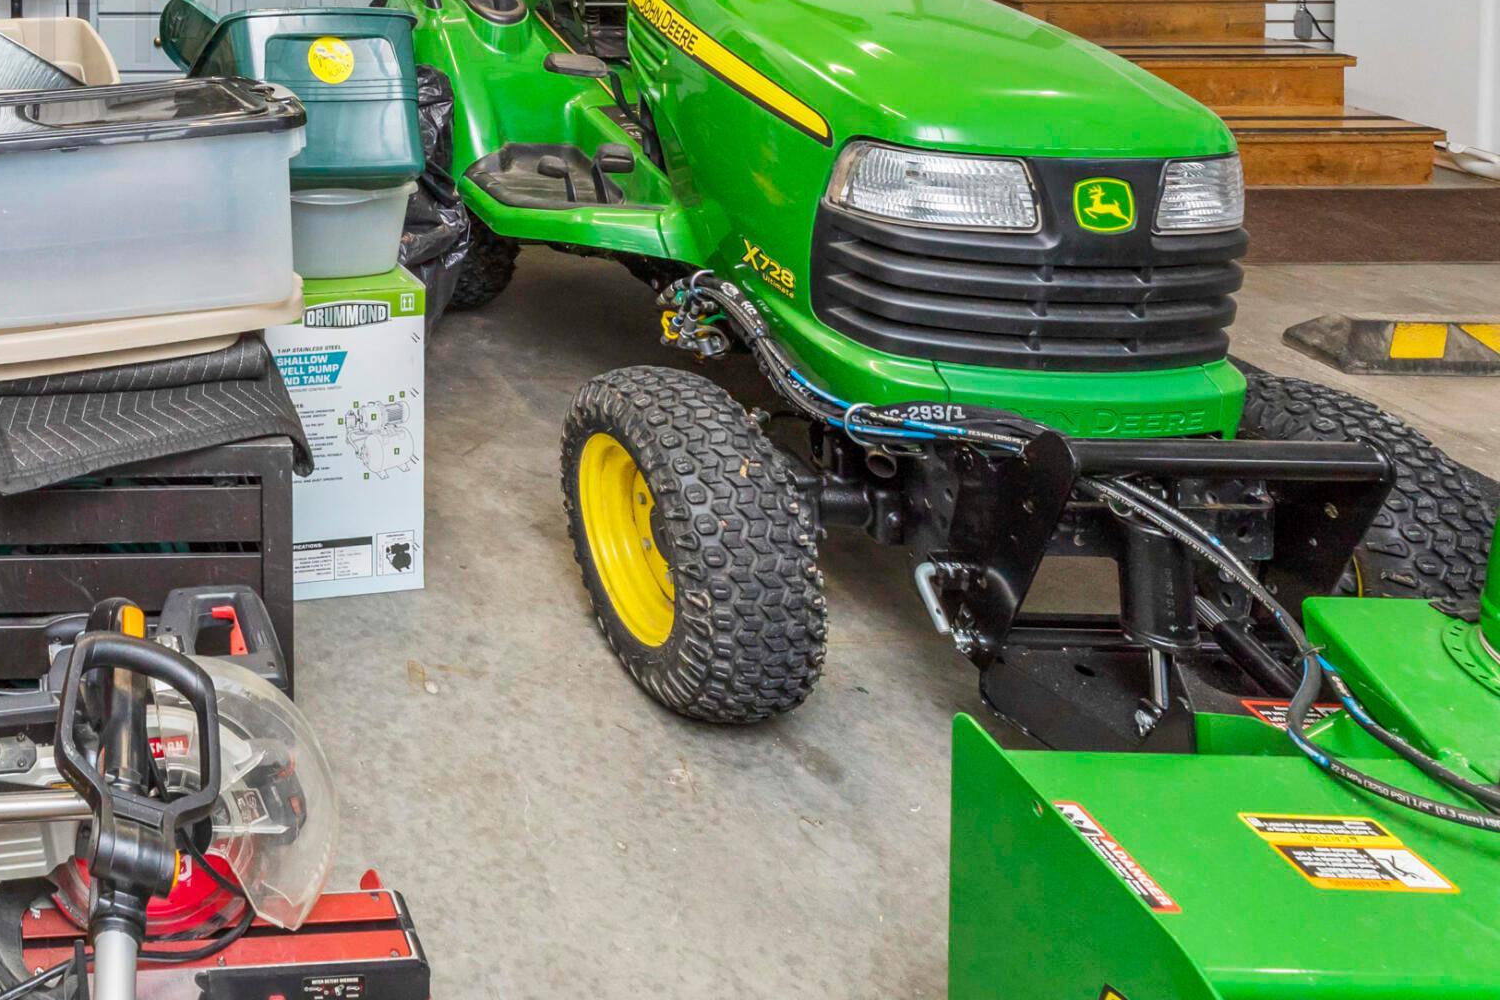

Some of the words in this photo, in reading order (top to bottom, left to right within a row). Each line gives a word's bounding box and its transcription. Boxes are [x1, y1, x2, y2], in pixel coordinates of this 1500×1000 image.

[660, 10, 699, 52] DEERE
[743, 238, 796, 289] X728
[761, 273, 795, 298] Ultimate
[306, 303, 387, 327] DRUMMOND
[277, 354, 329, 367] SHALLOW
[293, 345, 323, 353] STAINLESS
[284, 375, 300, 385] ND
[303, 374, 331, 384] TANK
[308, 363, 340, 374] PUMP
[1092, 407, 1205, 434] DEERE
[1301, 835, 1348, 843] CAUTION
[1113, 847, 1173, 906] DANGER
